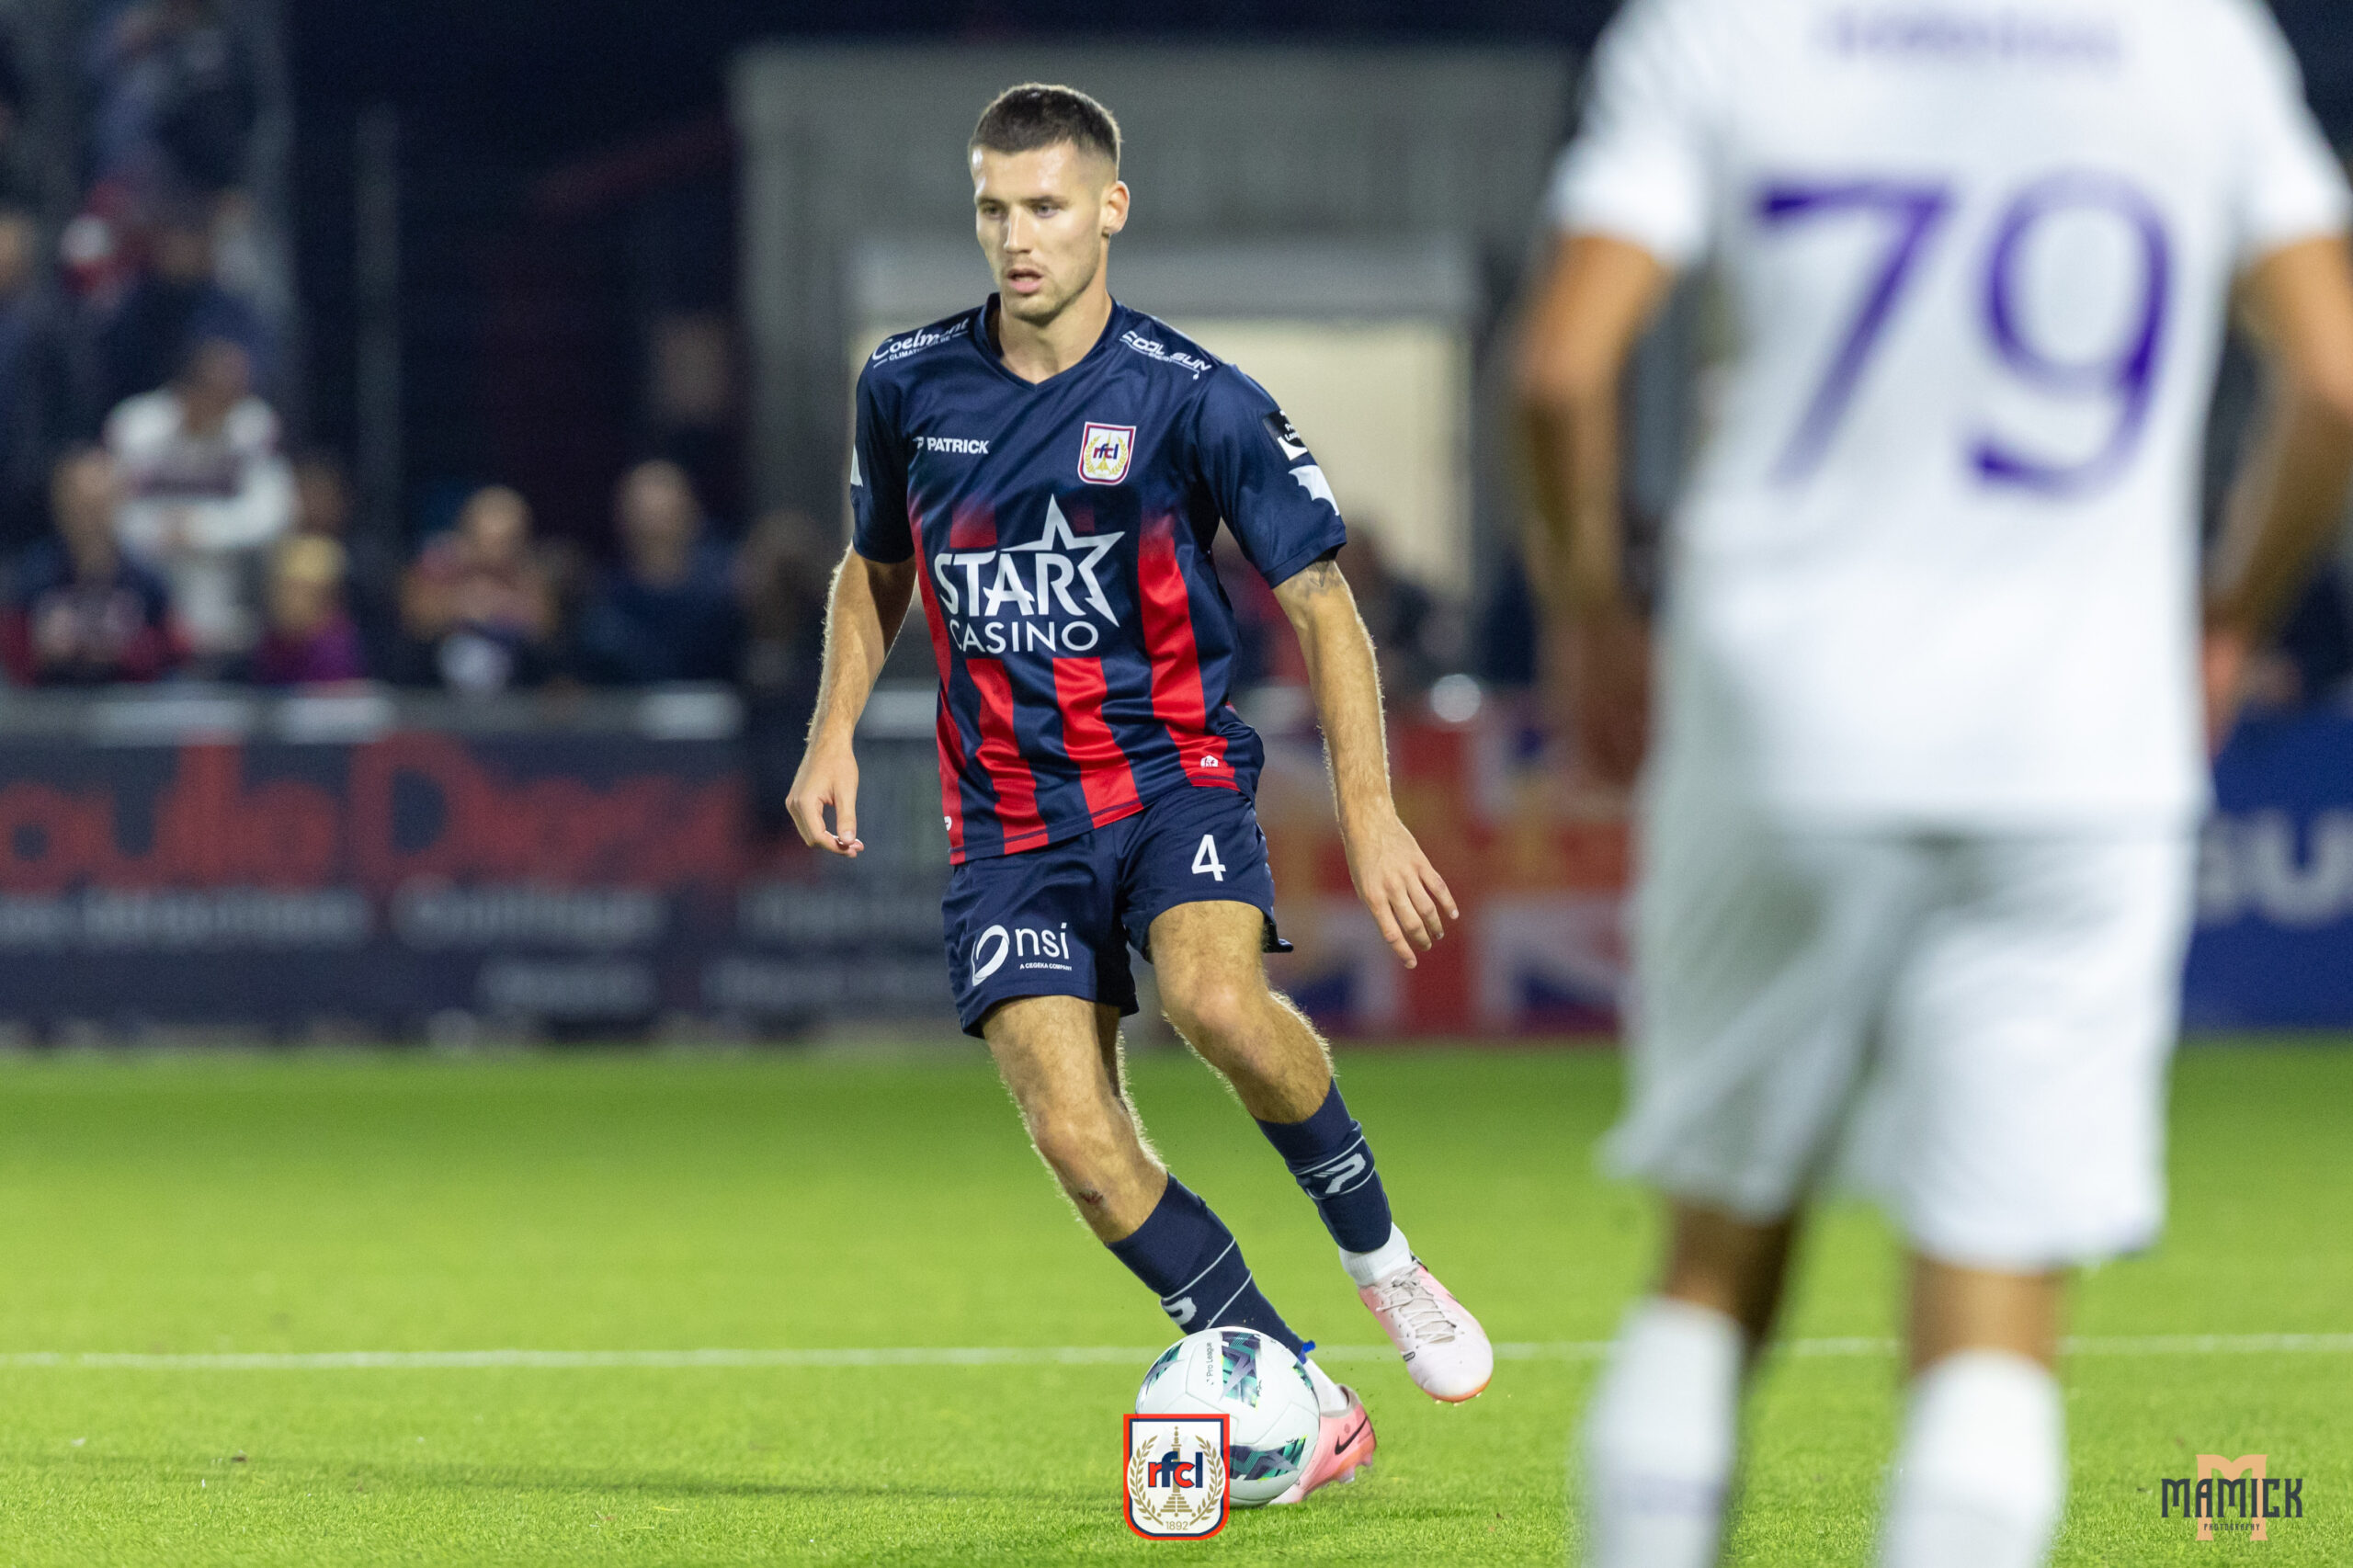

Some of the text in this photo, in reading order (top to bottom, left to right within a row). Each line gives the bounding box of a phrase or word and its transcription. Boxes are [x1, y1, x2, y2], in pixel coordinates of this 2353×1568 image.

[1754, 167, 2178, 501] 79
[1170, 352, 1212, 371] SUN
[926, 437, 990, 454] PATRICK
[1093, 443, 1120, 460] rfcl
[934, 550, 1087, 617] STAR
[949, 619, 1099, 654] CASINO
[1191, 834, 1227, 881] 4
[1015, 922, 1070, 960] nsi
